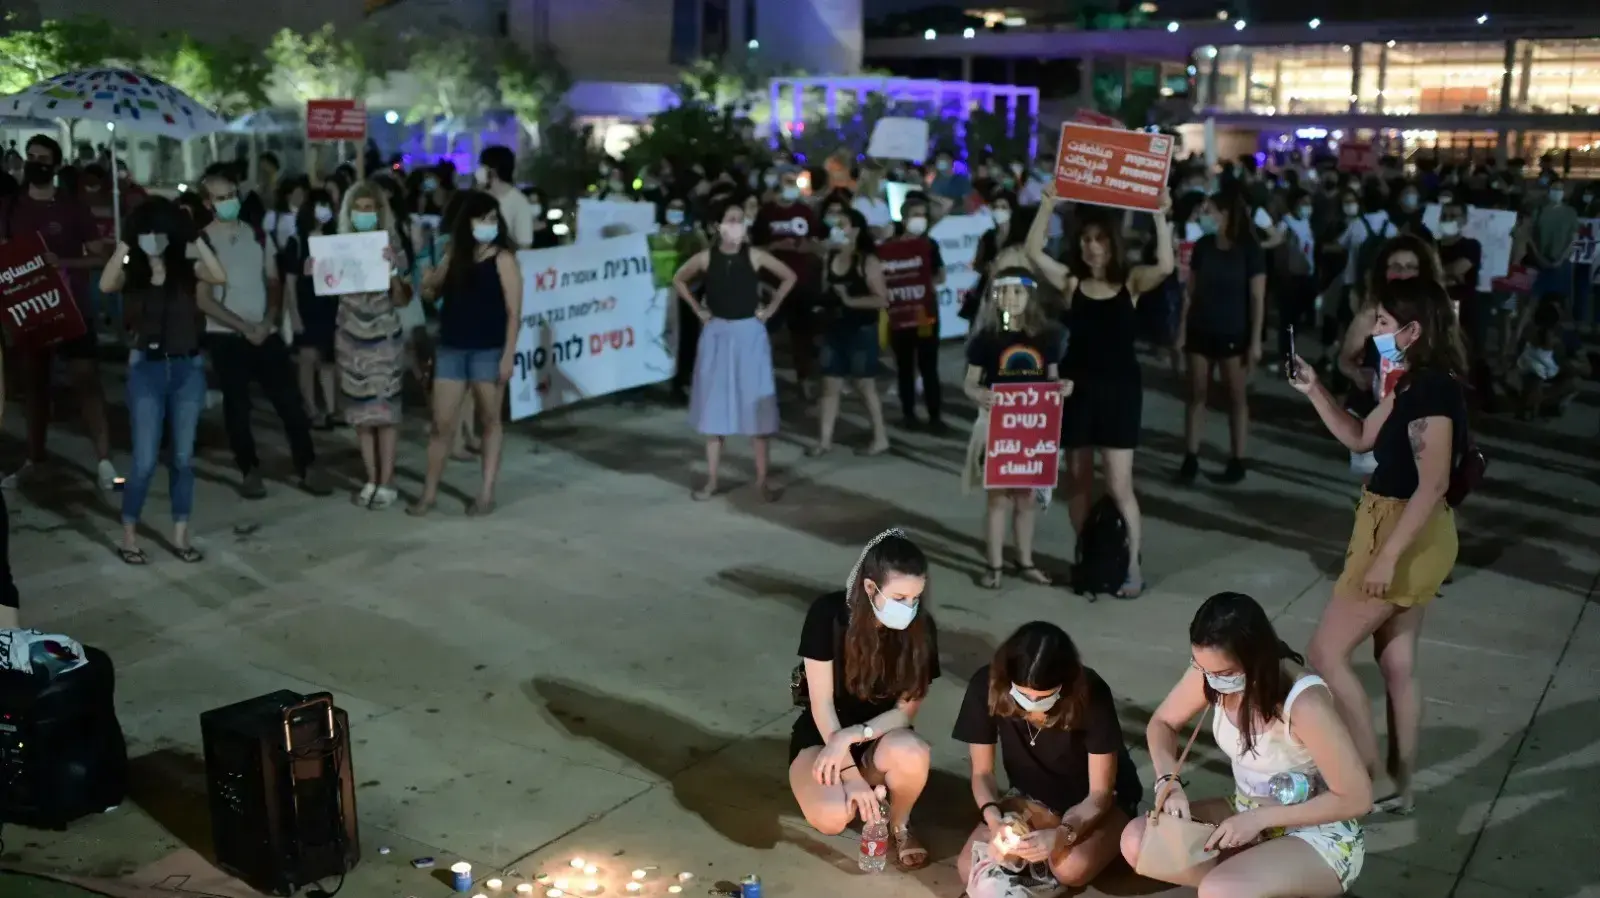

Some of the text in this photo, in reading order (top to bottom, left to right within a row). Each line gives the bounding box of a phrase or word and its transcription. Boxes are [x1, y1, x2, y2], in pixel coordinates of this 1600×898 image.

[535, 264, 558, 292] לא
[603, 256, 653, 279] ורנית
[7, 288, 60, 327] שוויון
[513, 325, 635, 380] נשים לזה סוף
[1003, 413, 1046, 428] נשים
[999, 460, 1043, 475] النساء
